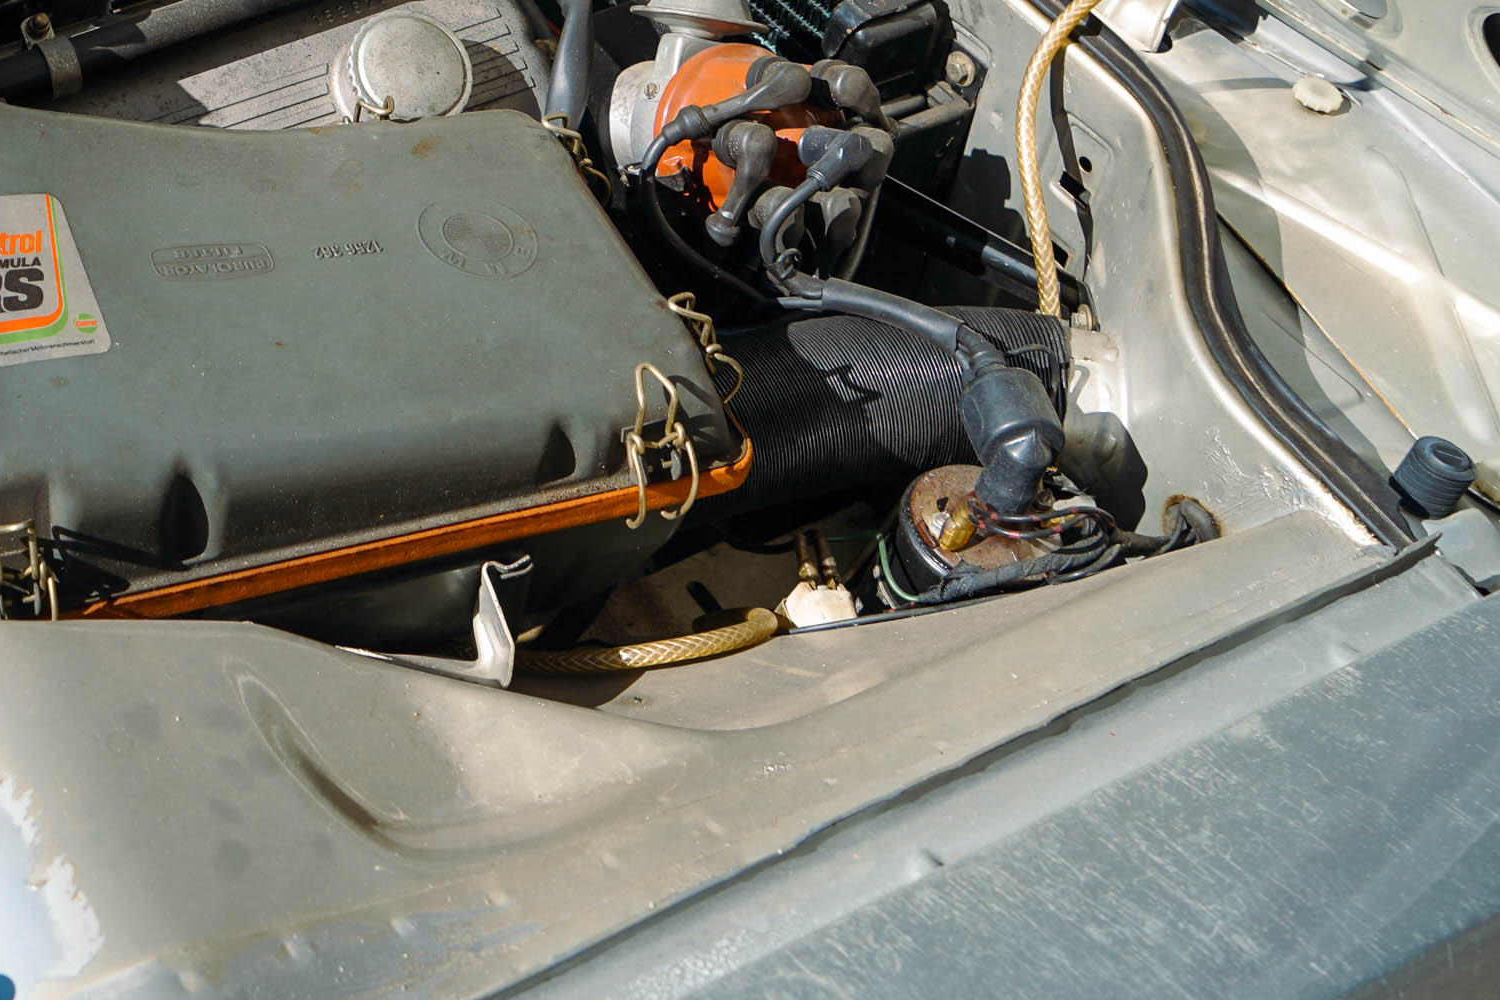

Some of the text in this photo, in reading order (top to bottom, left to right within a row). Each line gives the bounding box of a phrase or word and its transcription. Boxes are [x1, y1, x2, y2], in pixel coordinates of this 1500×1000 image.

[172, 246, 243, 260] FILTER
[313, 240, 383, 260] 1256 362
[161, 257, 268, 278] PUROLATOR
